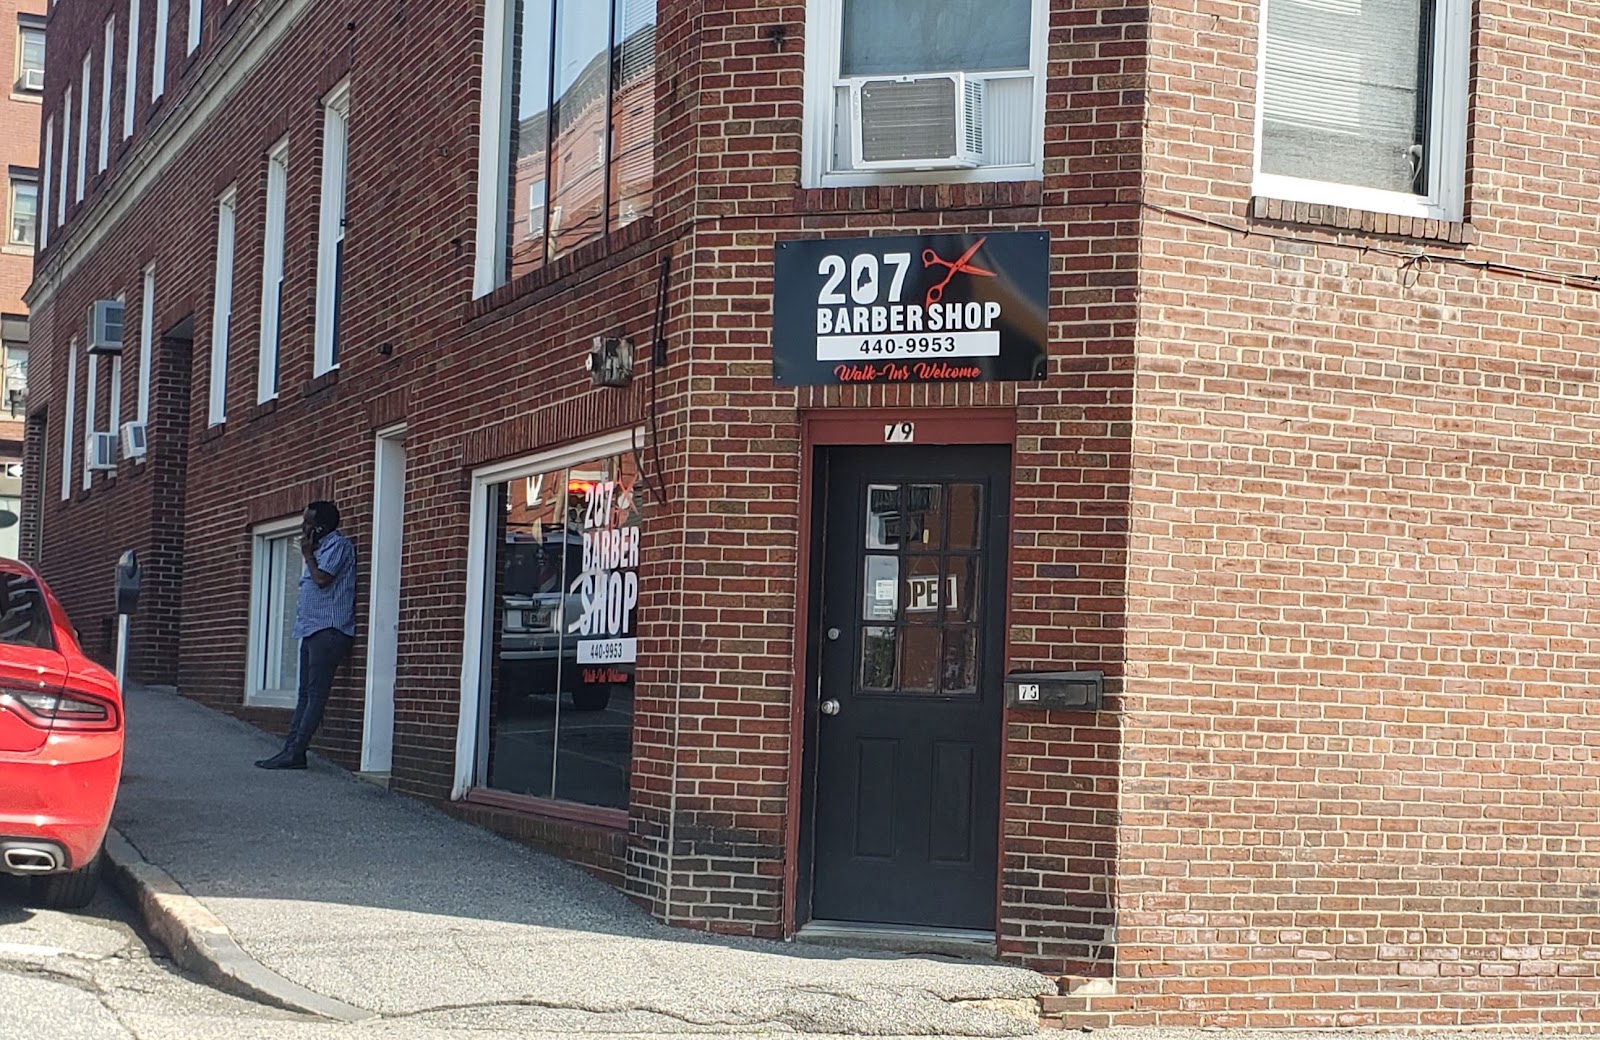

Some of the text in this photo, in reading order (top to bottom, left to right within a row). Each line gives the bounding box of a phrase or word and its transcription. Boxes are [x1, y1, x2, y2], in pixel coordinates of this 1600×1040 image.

[818, 253, 911, 305] 207
[860, 337, 955, 354] 440-9953
[834, 362, 981, 381] Walk-Ins Welcome
[885, 422, 913, 440] 79
[584, 481, 614, 529] 207
[582, 526, 639, 573] BARBER
[580, 571, 638, 636] SHOP
[590, 642, 622, 659] 440-9953
